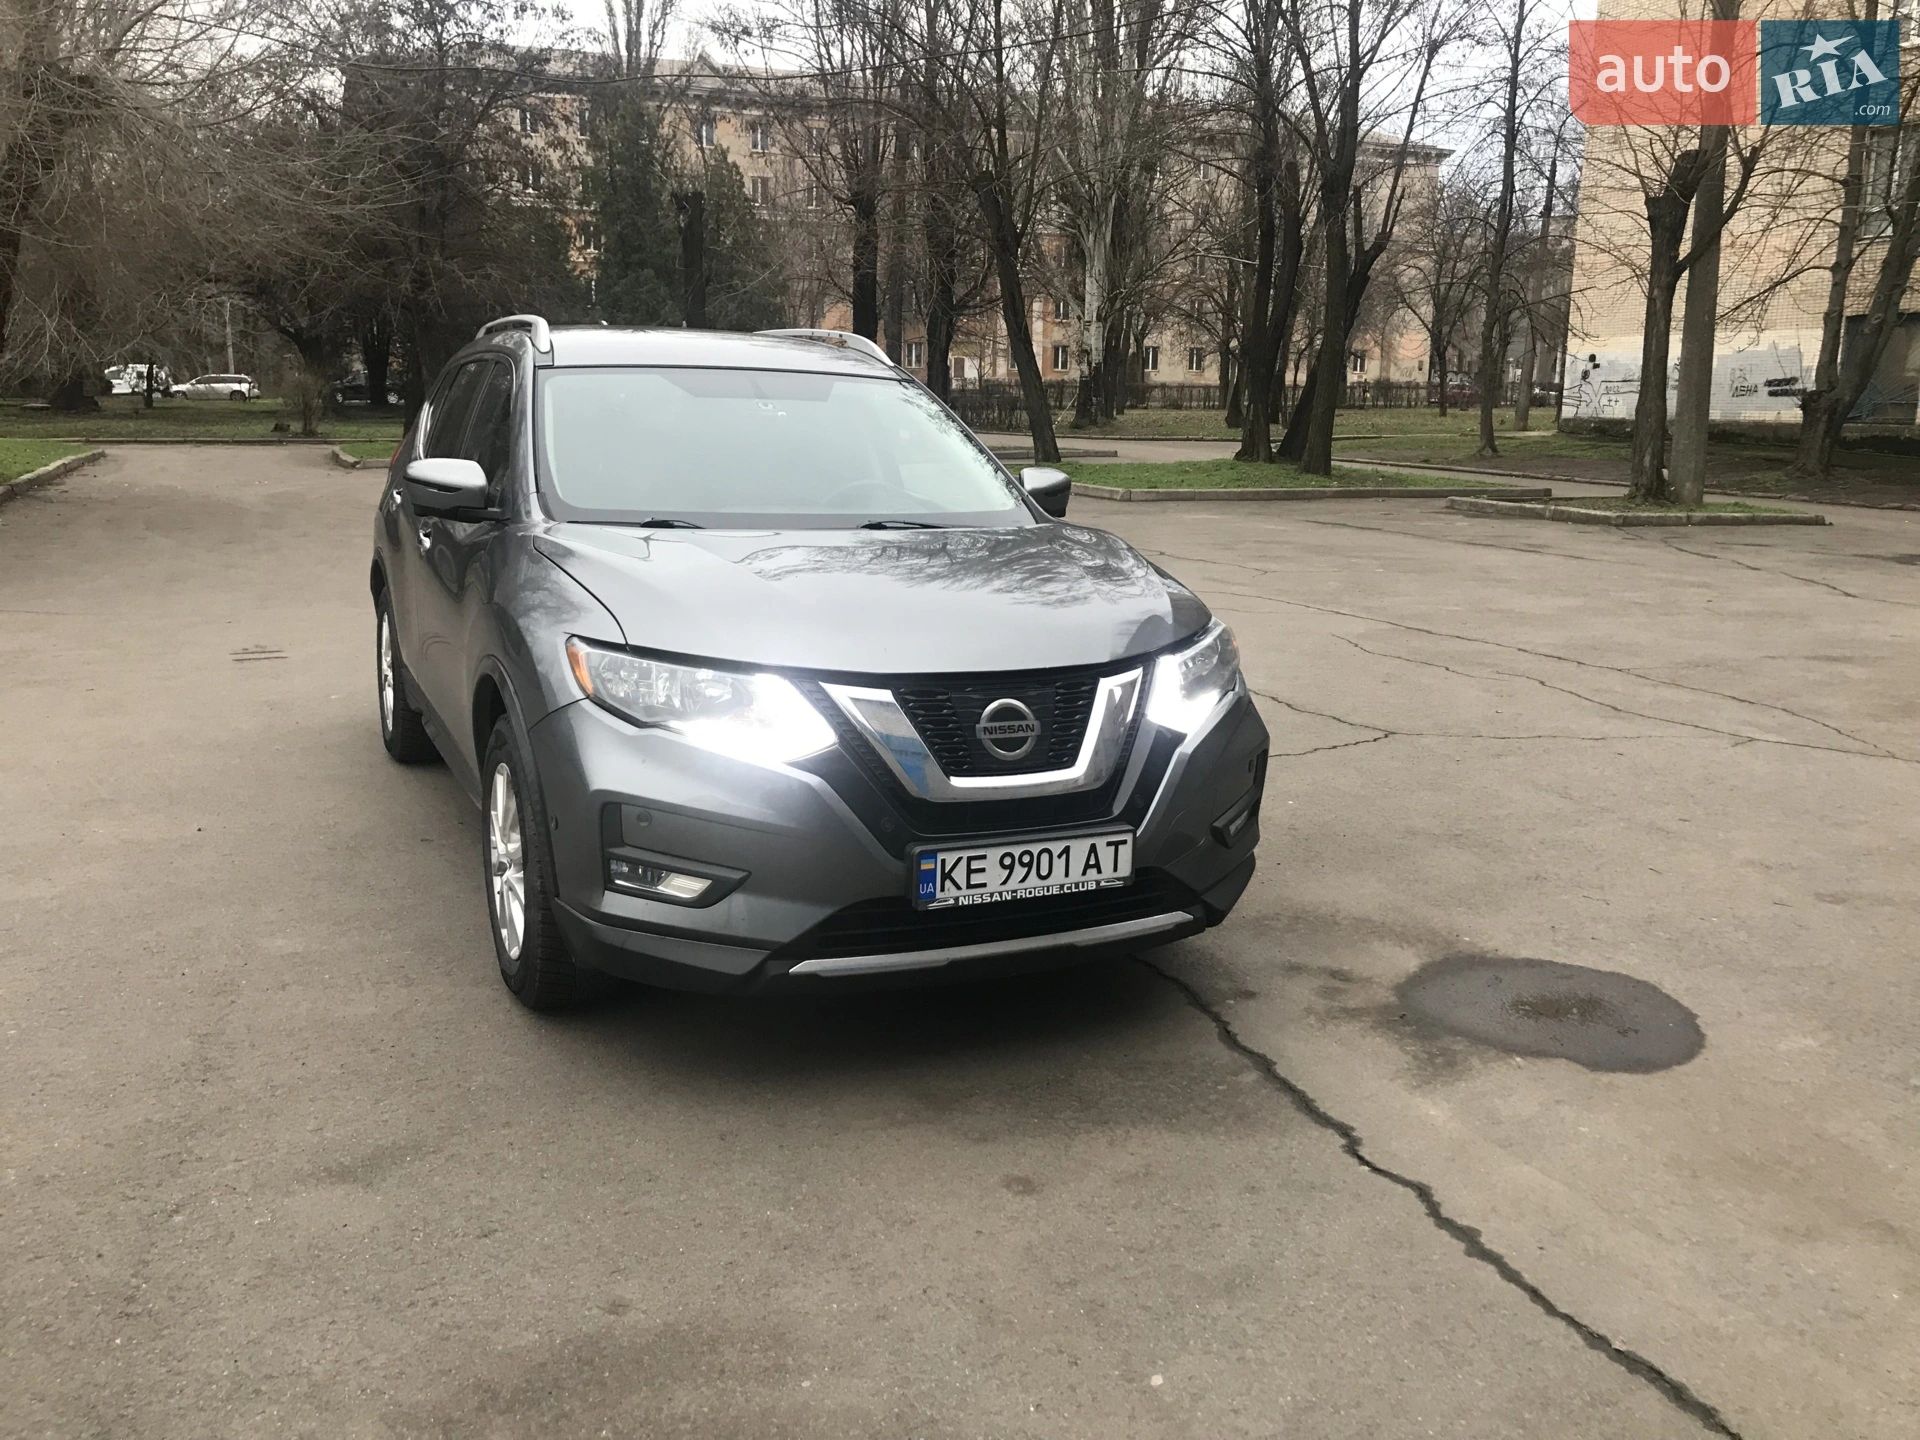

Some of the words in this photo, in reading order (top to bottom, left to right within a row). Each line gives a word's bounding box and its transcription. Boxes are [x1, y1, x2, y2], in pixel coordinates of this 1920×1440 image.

[983, 723, 1035, 735] NISSAN
[939, 853, 987, 893] KE
[999, 844, 1071, 886] 9901
[1081, 838, 1128, 876] AT
[919, 883, 935, 894] UA
[958, 880, 1096, 906] NISSAN-ROGUE.CLUB
